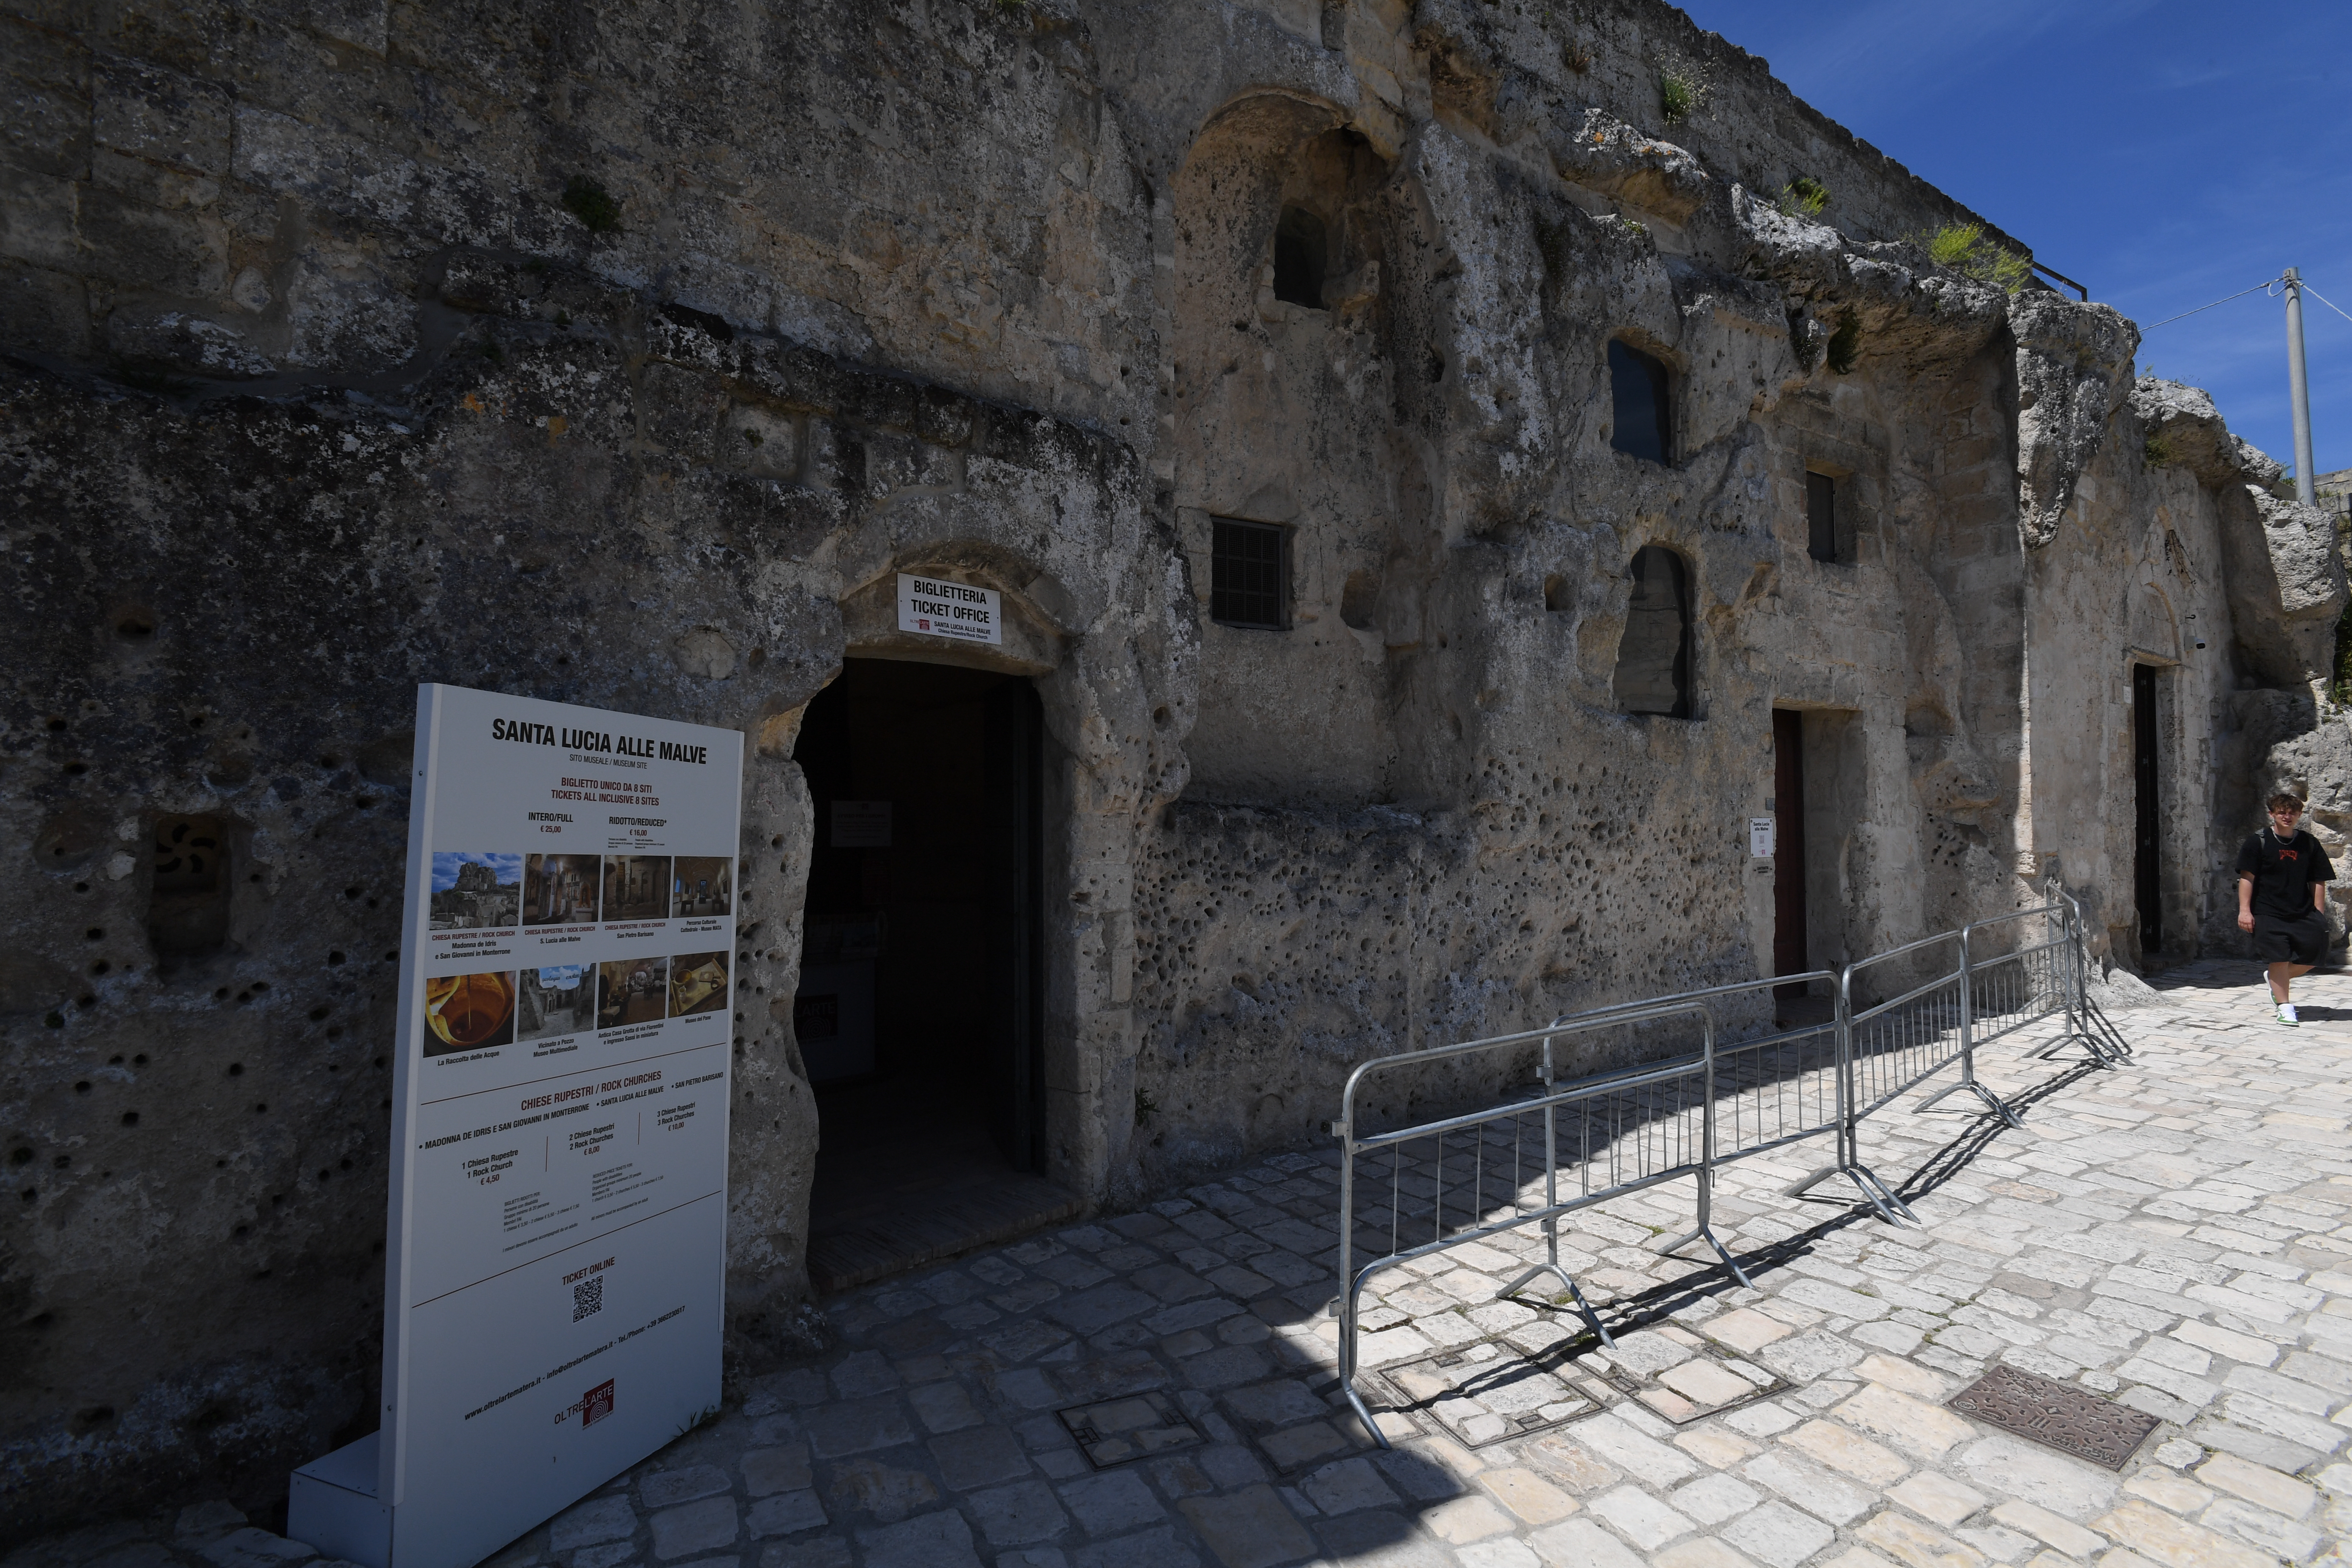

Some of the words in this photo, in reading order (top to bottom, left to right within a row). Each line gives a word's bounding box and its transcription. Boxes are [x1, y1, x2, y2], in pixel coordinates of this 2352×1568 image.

[914, 580, 987, 605] BIGLIETTERIA
[911, 599, 950, 617] TICKET
[953, 606, 990, 624] OFFICE
[492, 718, 555, 746] SANTA
[561, 728, 611, 753] LUCIA
[616, 736, 655, 758] ALLE
[659, 741, 707, 765] MALVE
[569, 754, 582, 762] SITO
[583, 755, 609, 765] MUSEALE
[613, 759, 636, 768] MUSEUM
[637, 761, 648, 769] SITE
[561, 777, 599, 789] BIGLIETTO
[600, 781, 621, 791] UNICO
[623, 783, 632, 792] DA
[634, 784, 638, 792] 8
[640, 784, 652, 793] SITI
[551, 789, 582, 800] TICKETS
[583, 792, 597, 802] ALL
[599, 793, 634, 804] INCLUSIVE
[635, 796, 640, 805] 8
[641, 796, 659, 806] SITES
[528, 812, 574, 822] INTERO/FULL
[545, 825, 561, 834] 25,00
[634, 829, 647, 837] 16,00
[452, 950, 475, 958] Giovanni
[646, 1022, 664, 1030] Fiorentini
[538, 1041, 557, 1049] Vicinato
[549, 1045, 578, 1055] Multimediale
[446, 1056, 469, 1065] Raccolta
[675, 1081, 685, 1089] SAN
[685, 1077, 701, 1086] PIETRO
[702, 1072, 724, 1082] BARISANO
[521, 1094, 552, 1111] CHIESE
[554, 1085, 593, 1103] RUPESTRI
[601, 1079, 622, 1093] ROCK
[623, 1070, 662, 1087] CHURCHES
[601, 1097, 618, 1107] SANTA
[619, 1093, 634, 1102] LUCIA
[634, 1089, 647, 1099] ALLE
[648, 1086, 664, 1095] MALVE
[661, 1108, 676, 1116] Chiese
[677, 1101, 695, 1112] Rupestri
[425, 1134, 461, 1149] MADONNA
[463, 1131, 472, 1141] DE
[474, 1127, 491, 1138] IDRIS
[493, 1125, 497, 1133] E
[498, 1122, 512, 1132] SAN
[513, 1114, 542, 1128] GIOVANNI
[543, 1113, 550, 1121] IN
[551, 1103, 590, 1119] MONTERRONE
[662, 1116, 673, 1125] Rock
[674, 1111, 694, 1121] Churches
[672, 1122, 684, 1130] 10,00
[574, 1130, 592, 1140] Chiese
[593, 1122, 615, 1135] Rupestri
[574, 1139, 588, 1149] Rock
[589, 1133, 613, 1145] Churches
[588, 1145, 600, 1154] 8,00
[468, 1157, 489, 1168] Chiesa
[491, 1149, 518, 1162] Rupestre
[473, 1167, 489, 1177] Rock
[490, 1160, 513, 1172] Church
[486, 1173, 500, 1184] 4,50
[562, 1267, 588, 1285] TICKET
[589, 1256, 615, 1274] ONLINE
[465, 1377, 541, 1421] www.oltrelartematera.it
[547, 1341, 613, 1379] info@oltrelartematera.it
[647, 1320, 656, 1329] +39
